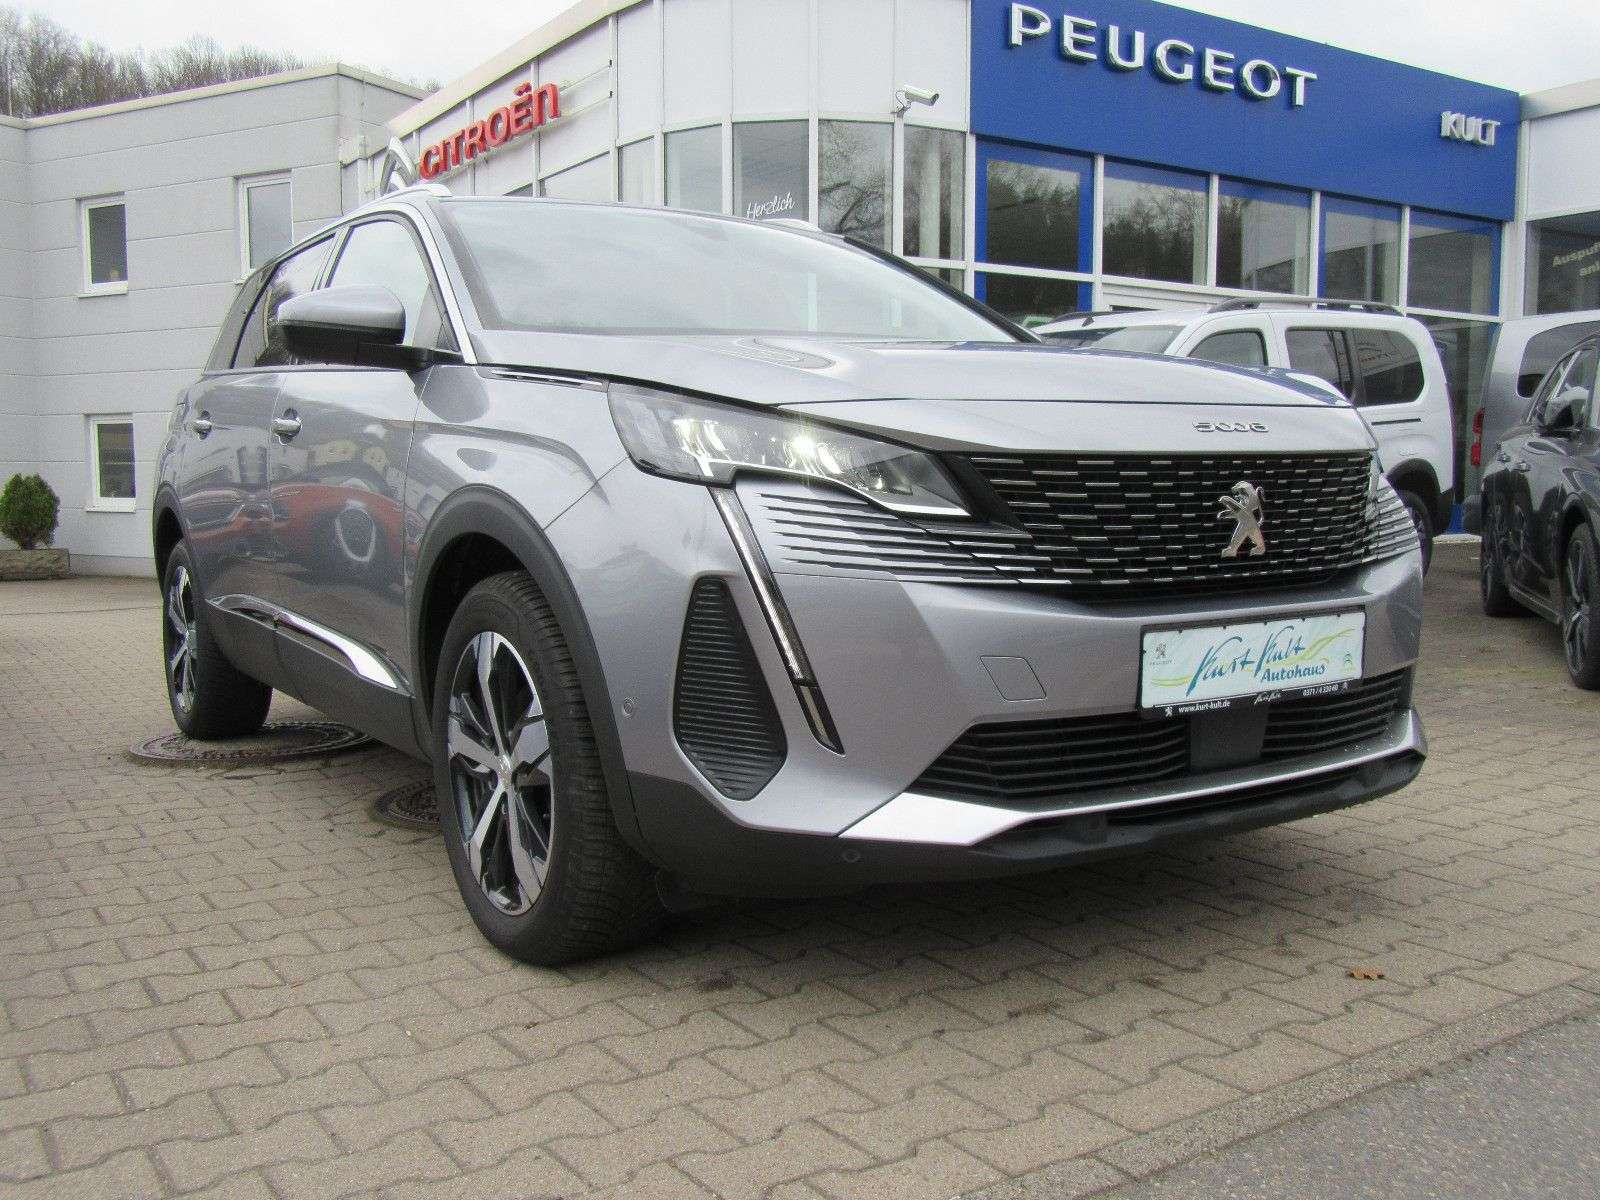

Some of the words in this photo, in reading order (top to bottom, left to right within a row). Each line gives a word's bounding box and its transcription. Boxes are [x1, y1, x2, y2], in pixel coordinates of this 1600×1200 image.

[1009, 2, 1319, 107] PEUGEOT
[1439, 110, 1501, 146] KULT
[746, 191, 795, 220] Herzlich
[1260, 663, 1327, 683] Autohaus
